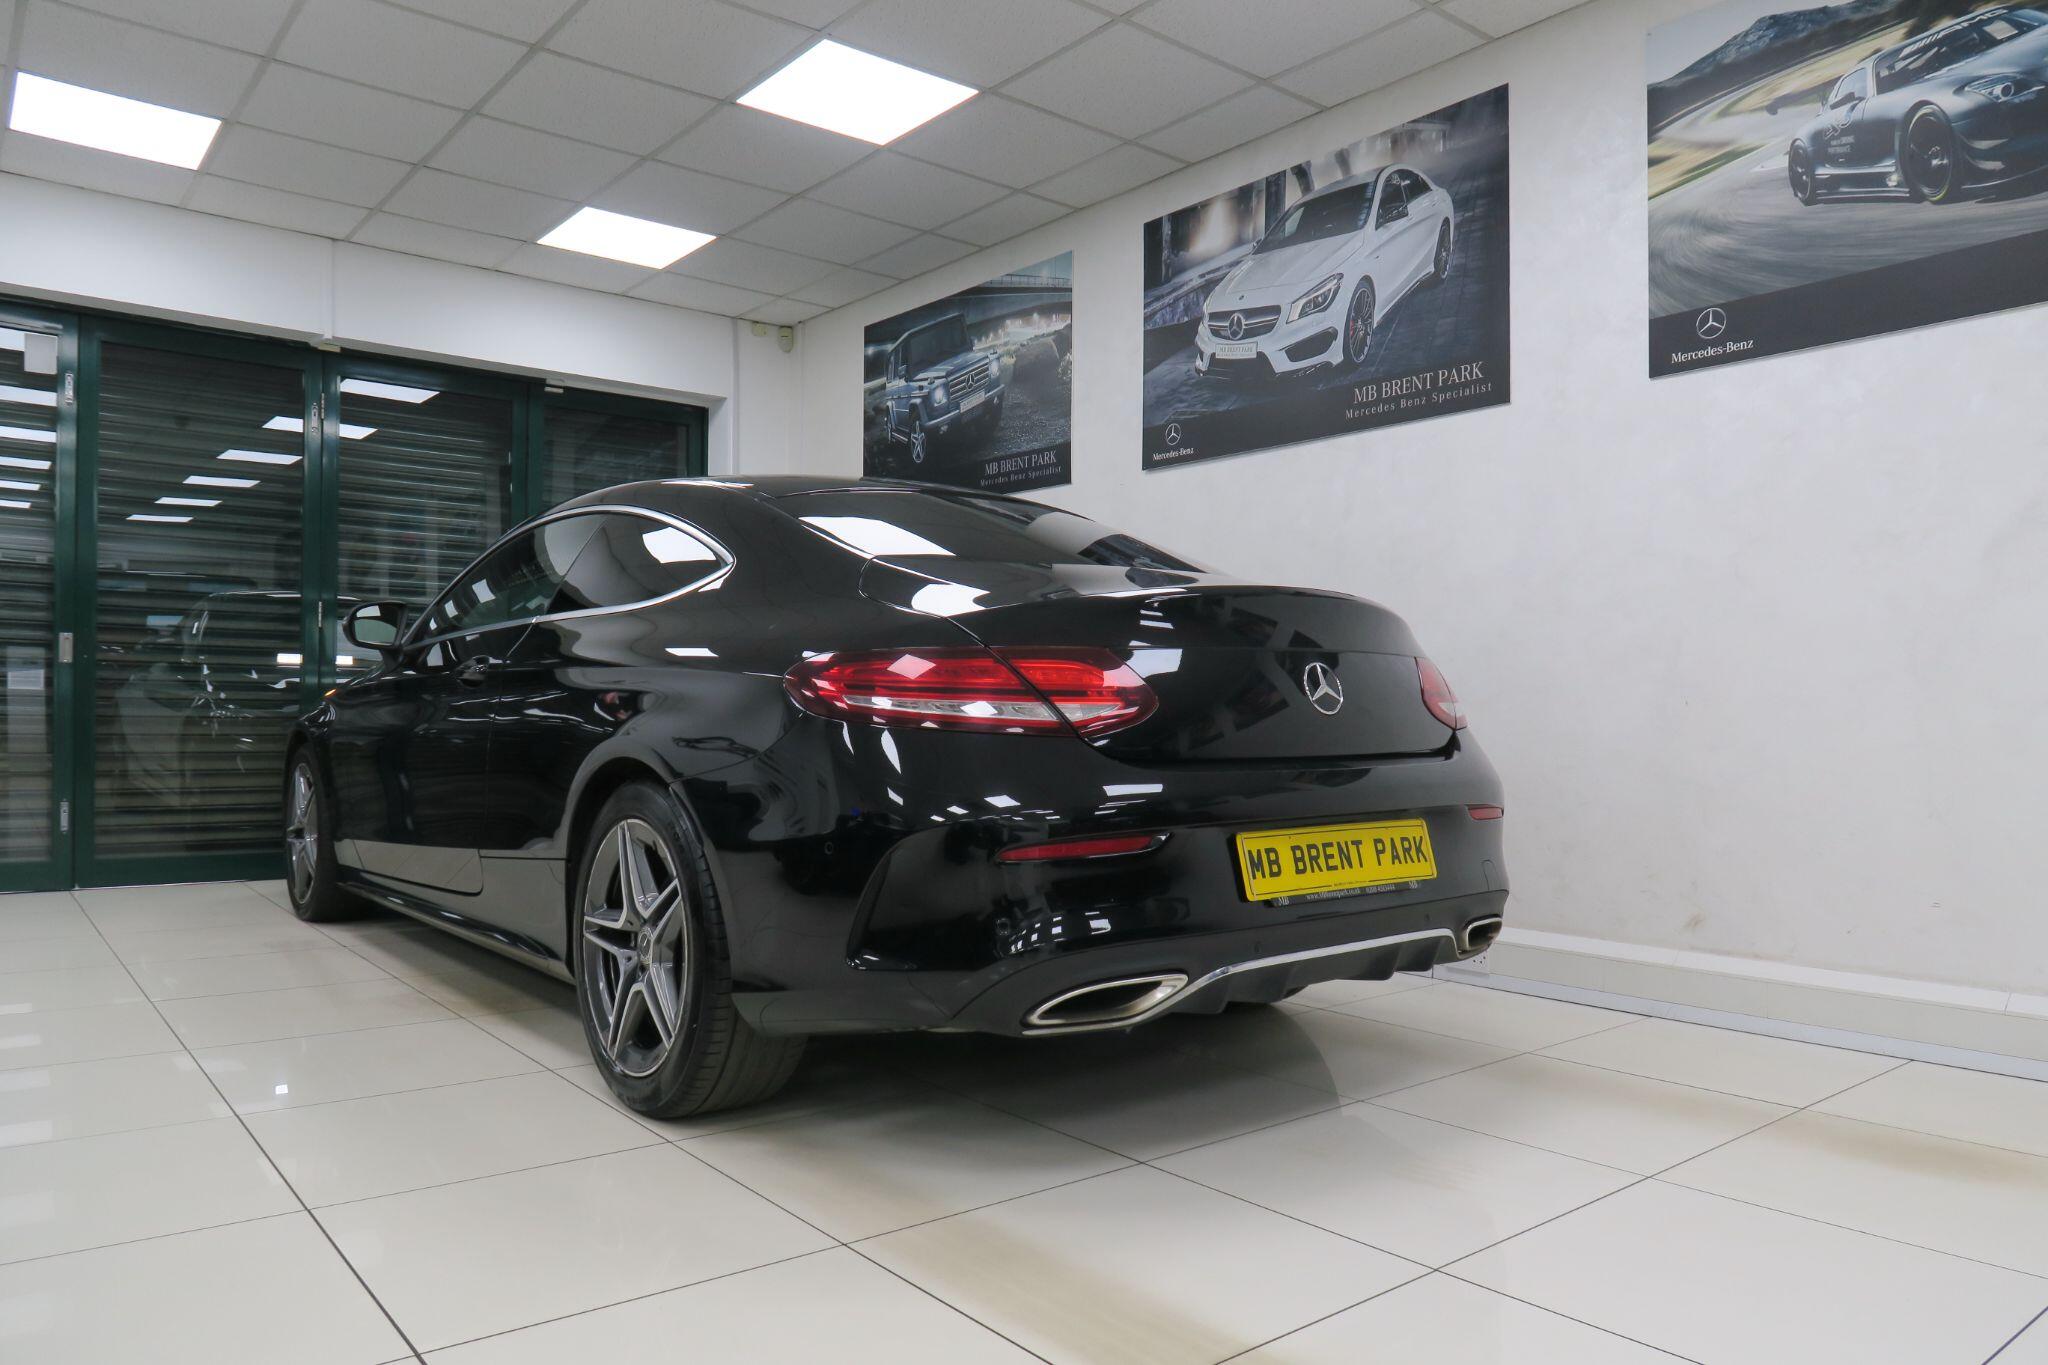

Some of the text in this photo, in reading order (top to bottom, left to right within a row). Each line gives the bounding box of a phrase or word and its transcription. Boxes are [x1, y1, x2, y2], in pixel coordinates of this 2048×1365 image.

[1671, 339, 1754, 364] Mercedes-Benz
[1345, 381, 1493, 420] Mercedes Benz Specialist
[1353, 361, 1484, 404] MB BRENT PARK
[984, 450, 1057, 476] MB BRENT PARK
[1247, 835, 1429, 880] MB BRENT PARK
